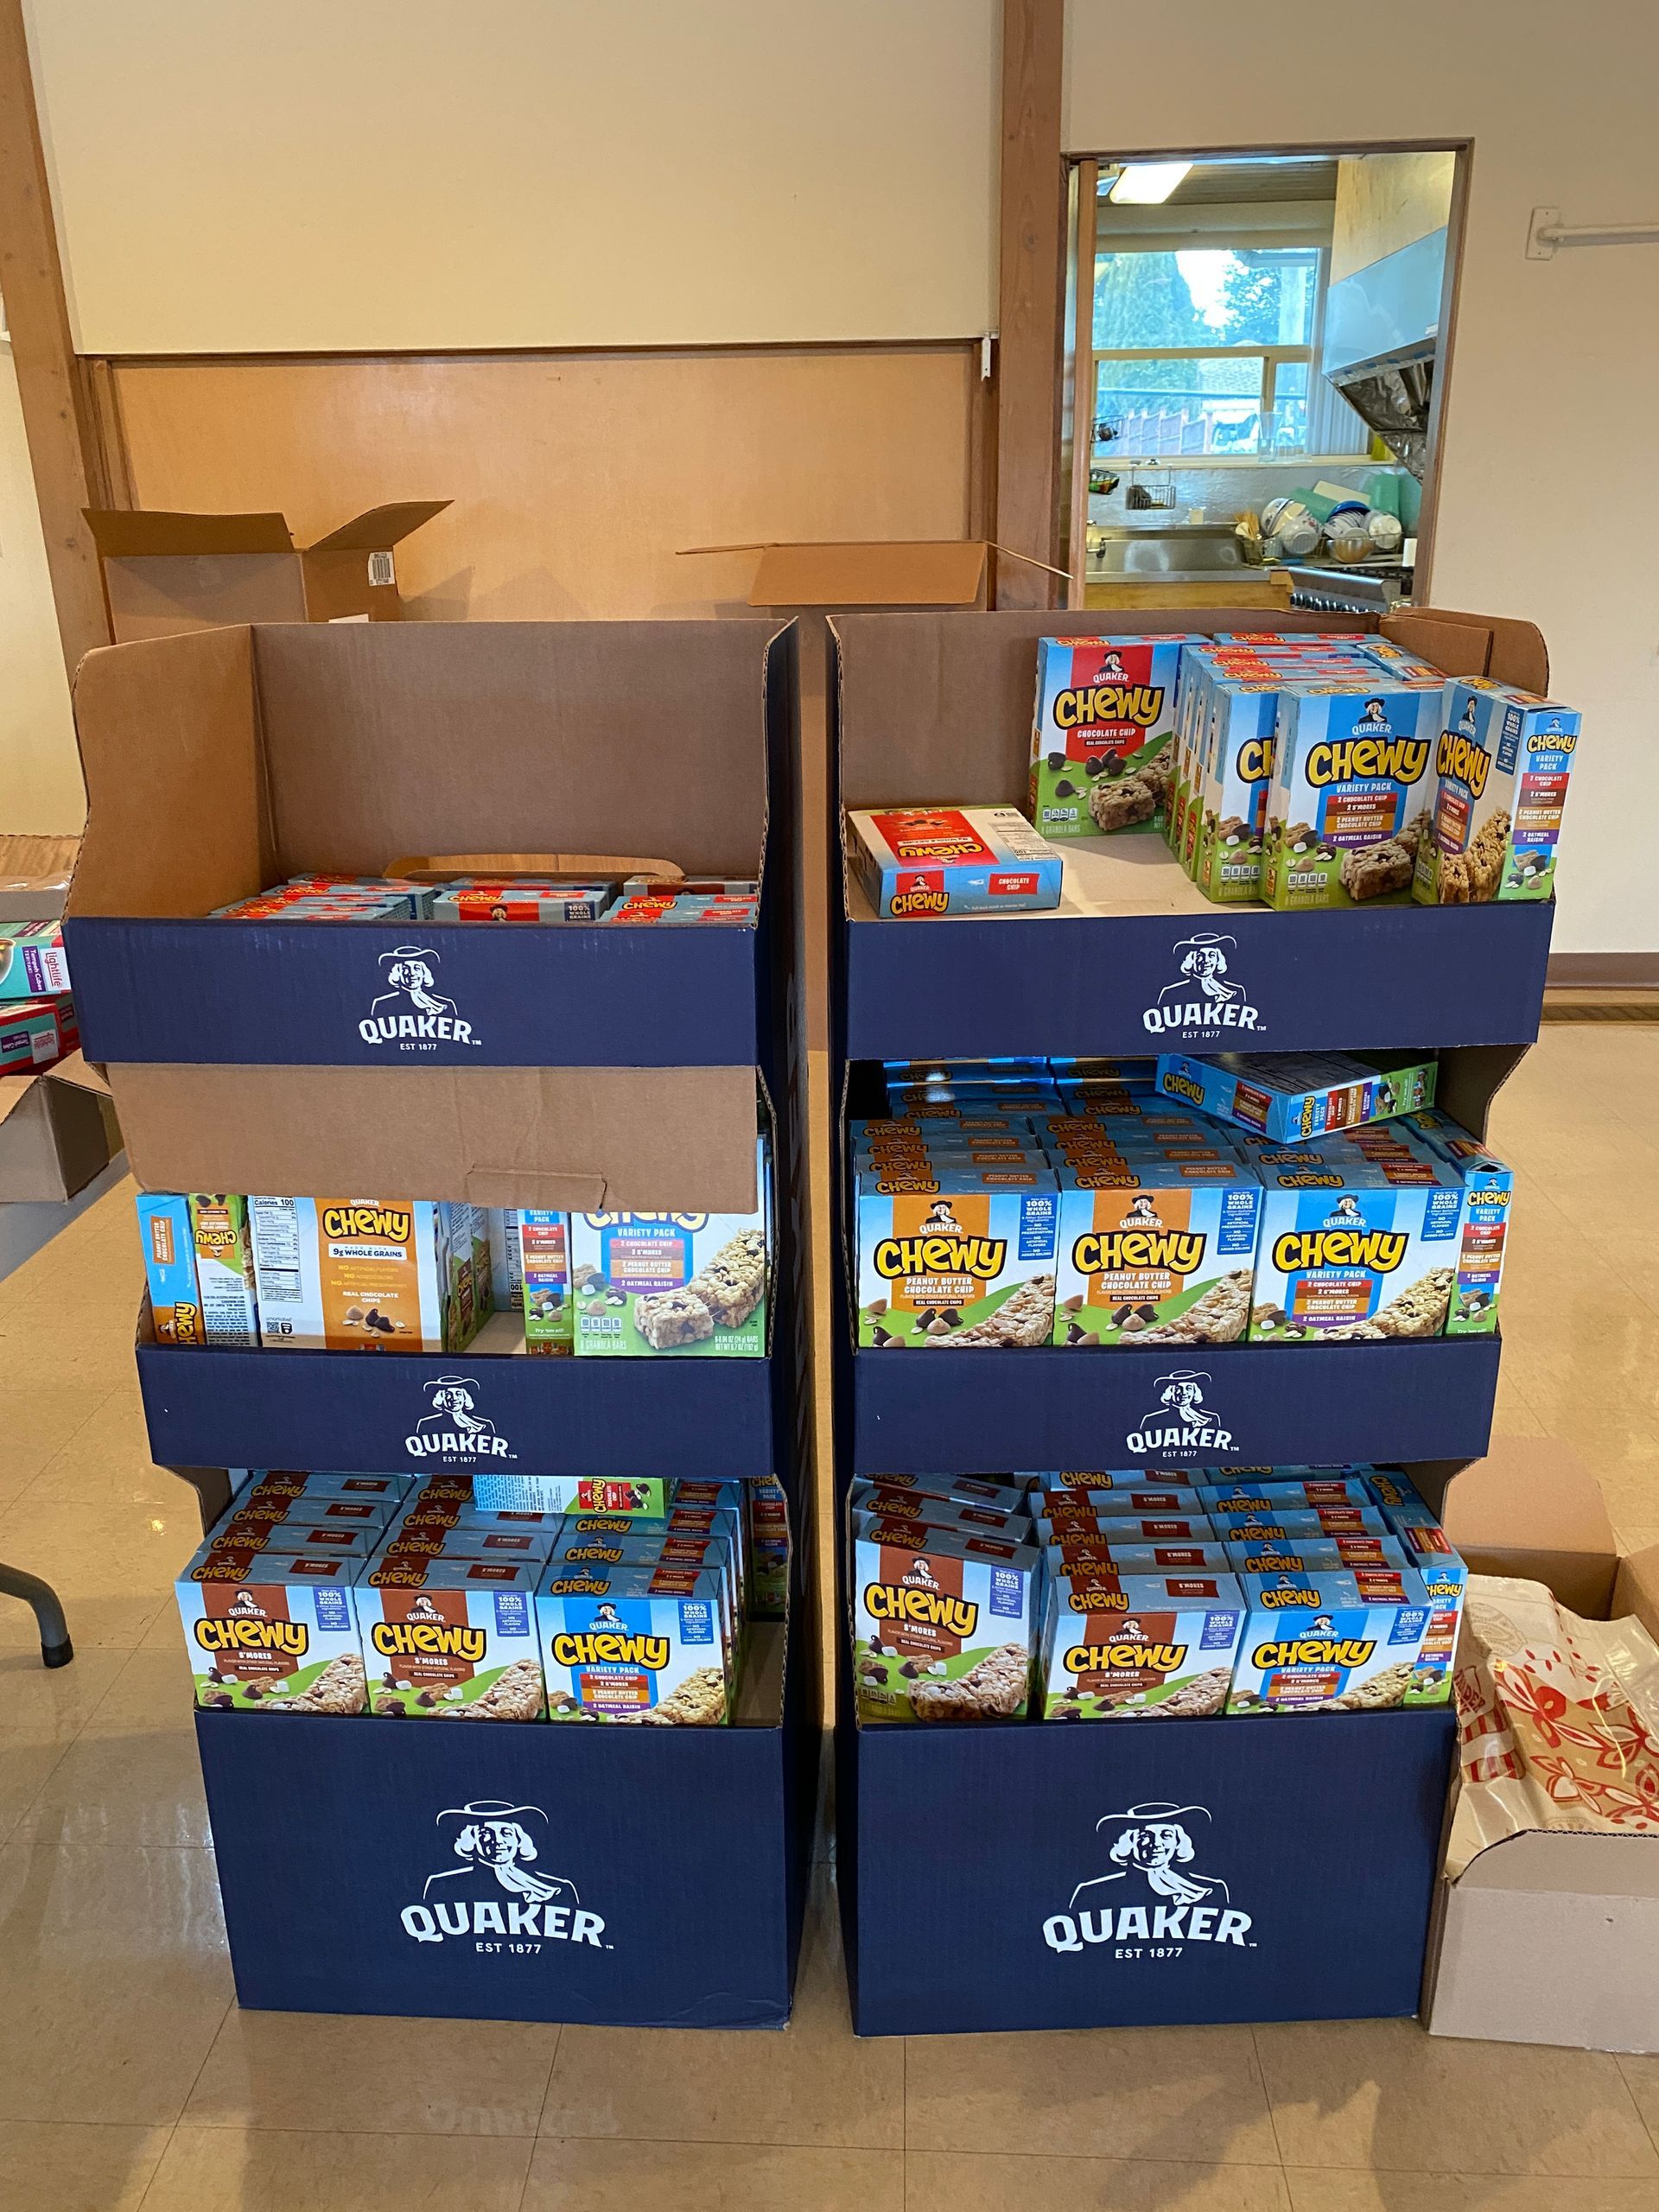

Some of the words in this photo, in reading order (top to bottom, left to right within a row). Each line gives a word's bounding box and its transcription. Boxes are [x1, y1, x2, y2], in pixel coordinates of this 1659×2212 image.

[1093, 672, 1128, 683] QUAKER
[1351, 722, 1392, 734] QUAKER
[1337, 784, 1372, 793] VARIETY
[1374, 782, 1391, 791] PACK
[45, 952, 62, 988] lightlife
[1143, 1003, 1258, 1033] QUAKER
[359, 1015, 472, 1044] QUAKER
[919, 1223, 963, 1234] QUAKER
[1120, 1217, 1163, 1229] QUAKER
[1323, 1217, 1367, 1228] QUAKER
[617, 1229, 651, 1237] VARIETY
[652, 1229, 676, 1237] PACK
[1306, 1270, 1342, 1279] VARIETY
[904, 1286, 952, 1294] CHOCOLATE
[405, 1433, 509, 1457] QUAKER
[1127, 1427, 1232, 1453] QUAKER
[902, 1576, 940, 1590] QUAKER
[228, 1607, 268, 1617] QUAKER
[407, 1613, 446, 1622] QUAKER
[589, 1622, 629, 1631] QUAKER
[904, 1624, 937, 1637] S'MORES
[1109, 1634, 1149, 1643] QUAKER
[400, 1902, 605, 1948] QUAKER
[1043, 1906, 1252, 1953] QUAKER
[476, 1942, 502, 1953] EST
[509, 1944, 541, 1954] 1877
[1116, 1948, 1143, 1959] EST
[1149, 1947, 1183, 1958] 1877
